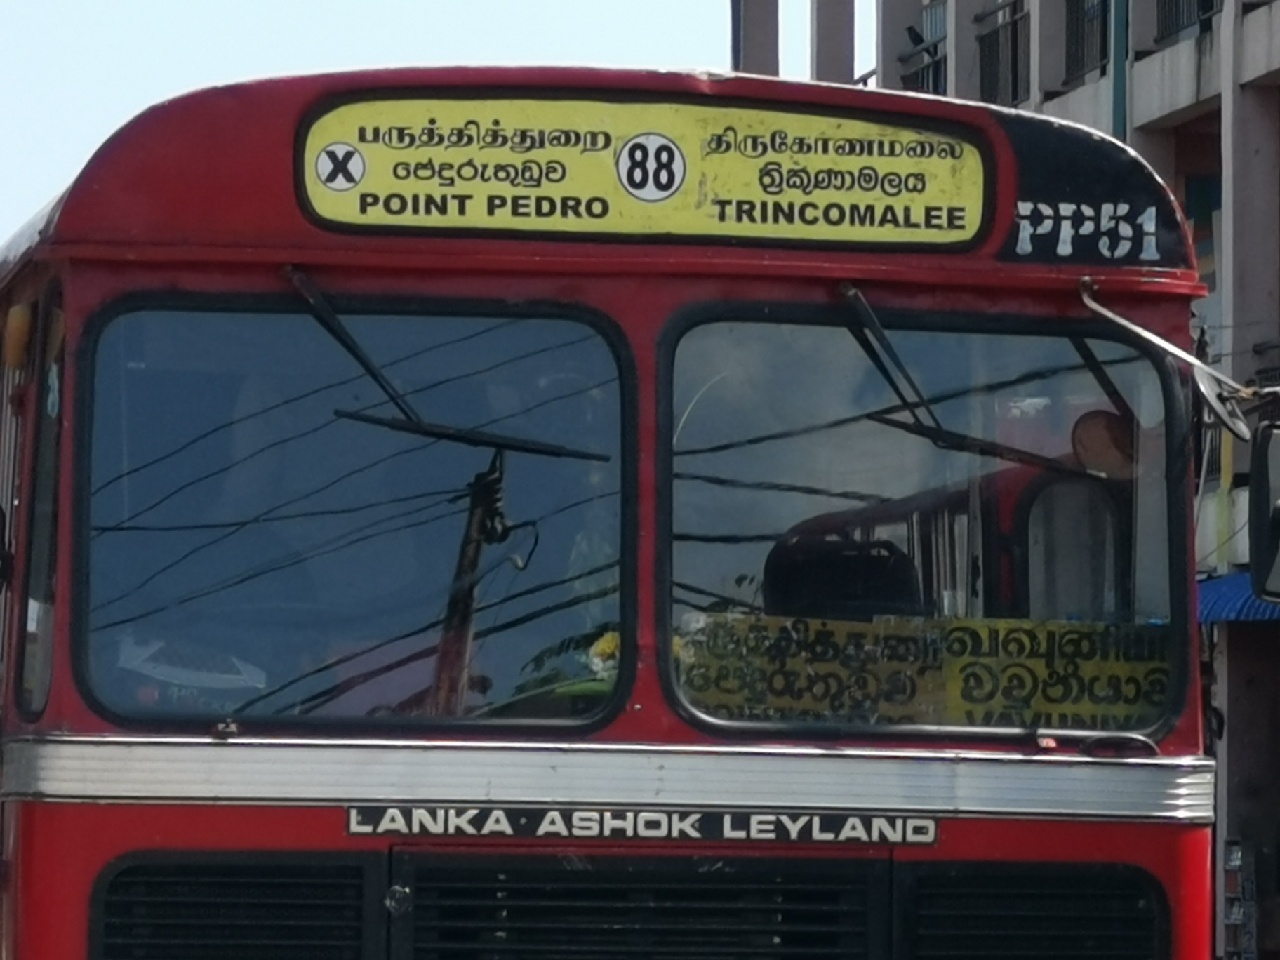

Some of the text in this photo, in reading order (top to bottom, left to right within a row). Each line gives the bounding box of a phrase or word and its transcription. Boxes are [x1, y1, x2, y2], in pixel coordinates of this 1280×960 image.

[357, 118, 612, 155] பருத்தித்துறை
[704, 126, 964, 160] திருகோணமலை
[324, 150, 356, 184] X
[626, 142, 676, 193] 88
[358, 192, 610, 220] POINT PEDRO
[714, 199, 967, 231] TRINCOMALEE
[1014, 199, 1161, 262] PP51
[348, 806, 937, 844] LANKA ASHOK LEYLAND
